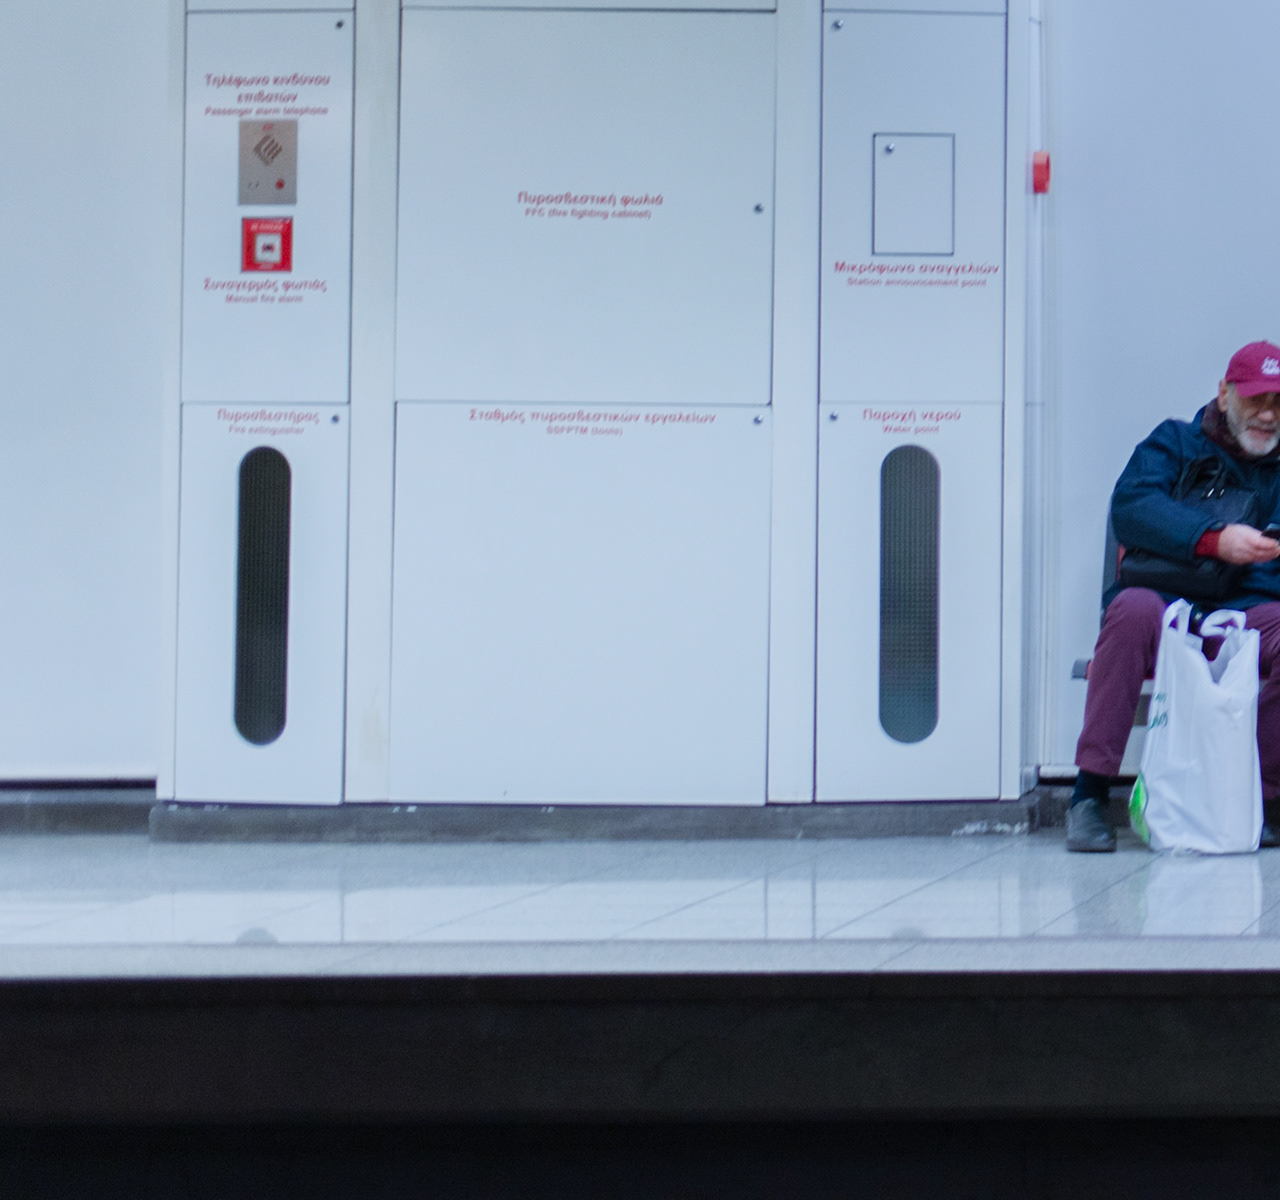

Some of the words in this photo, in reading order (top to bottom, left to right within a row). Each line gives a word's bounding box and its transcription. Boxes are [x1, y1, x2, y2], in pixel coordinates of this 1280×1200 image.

[517, 191, 617, 207] Πυροσβεστική
[834, 260, 915, 276] Μικρόφωνο
[919, 261, 1000, 276] αναγγελιών
[469, 408, 525, 424] Σταθμός
[863, 408, 917, 423] Παροχή
